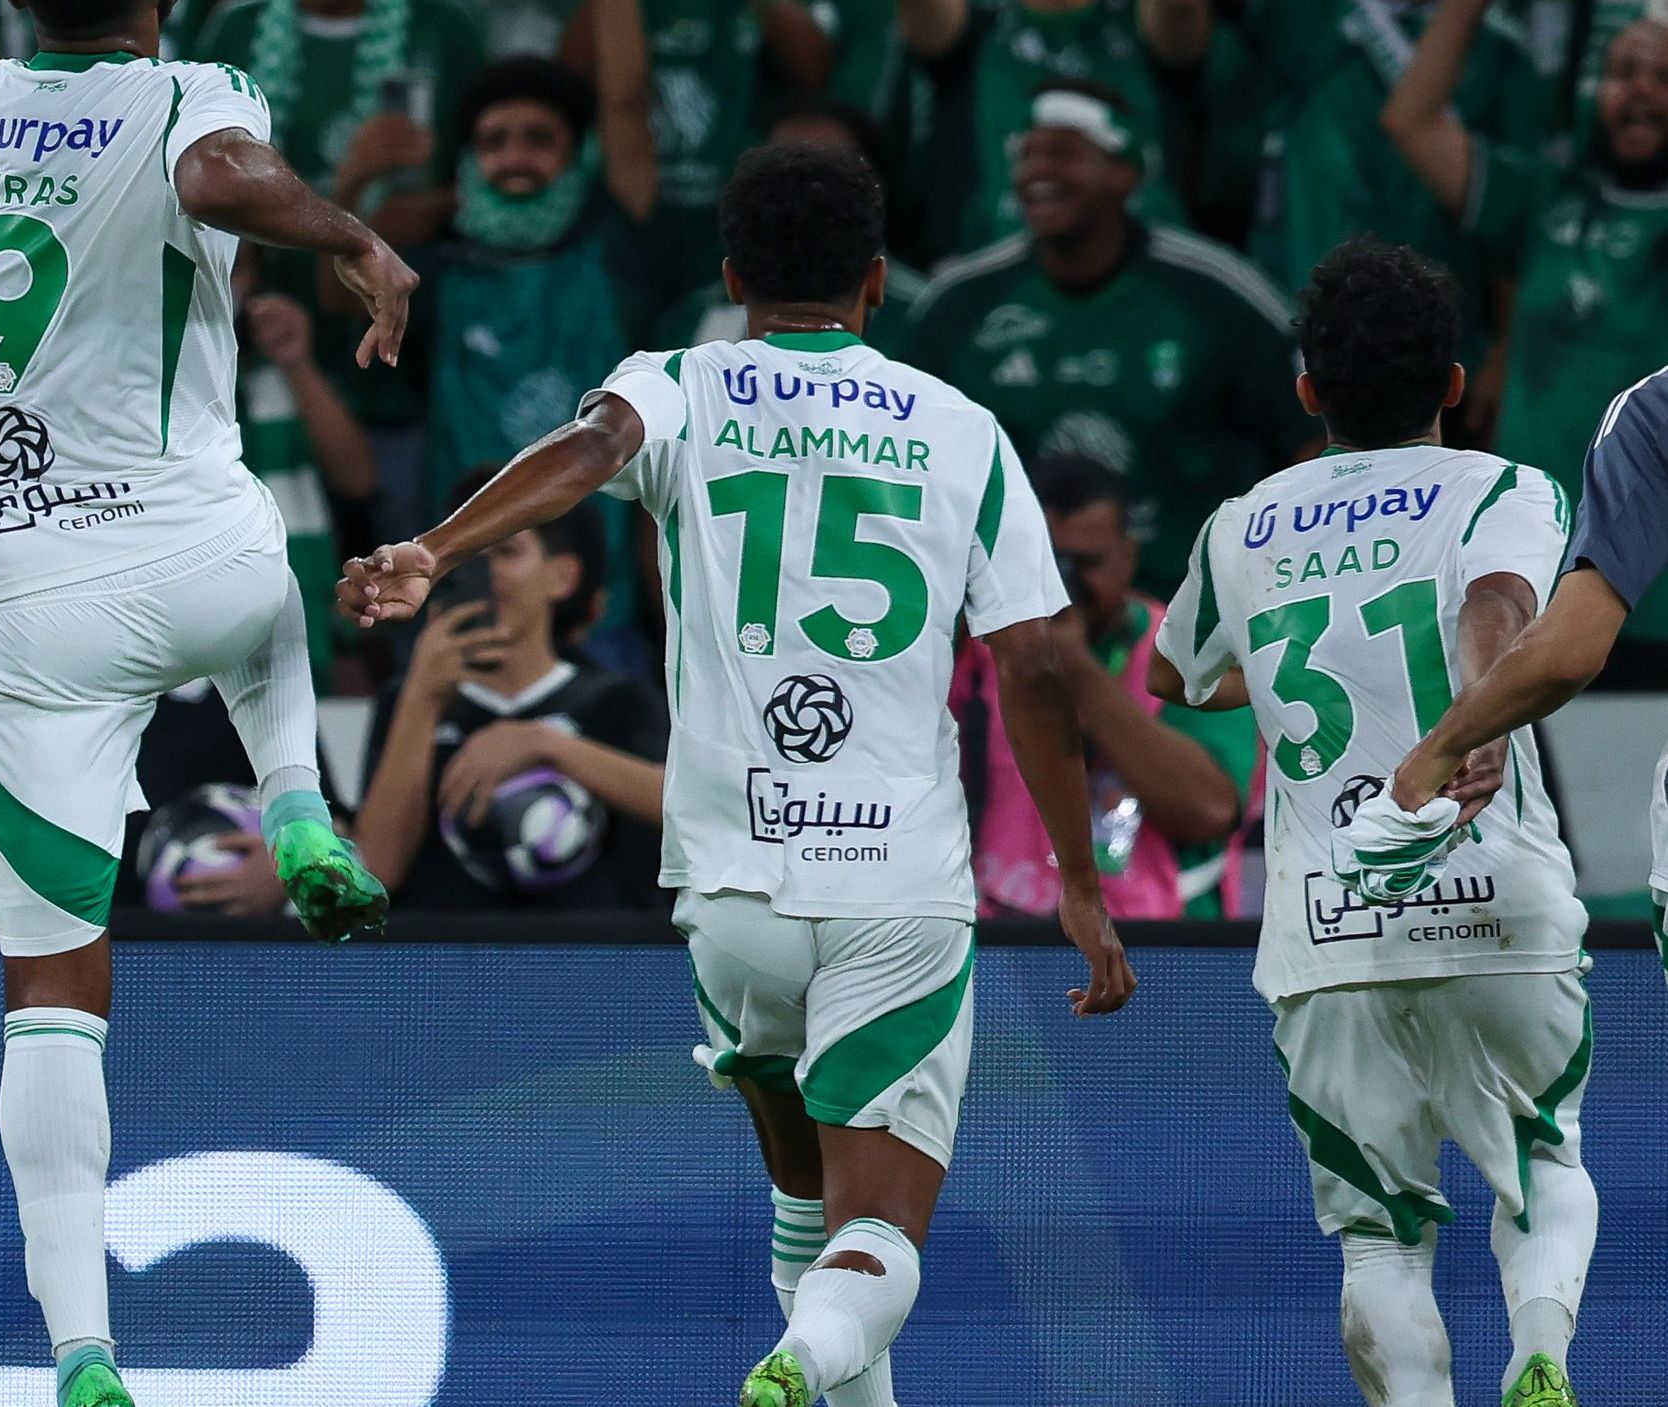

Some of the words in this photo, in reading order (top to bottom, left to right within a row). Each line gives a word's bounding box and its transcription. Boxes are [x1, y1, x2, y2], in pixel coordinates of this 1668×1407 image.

[713, 417, 931, 472] ALAMMAR
[1292, 483, 1442, 533] urpay
[707, 470, 929, 662] 15
[1274, 539, 1401, 589] SAAD
[1247, 577, 1456, 784] 31
